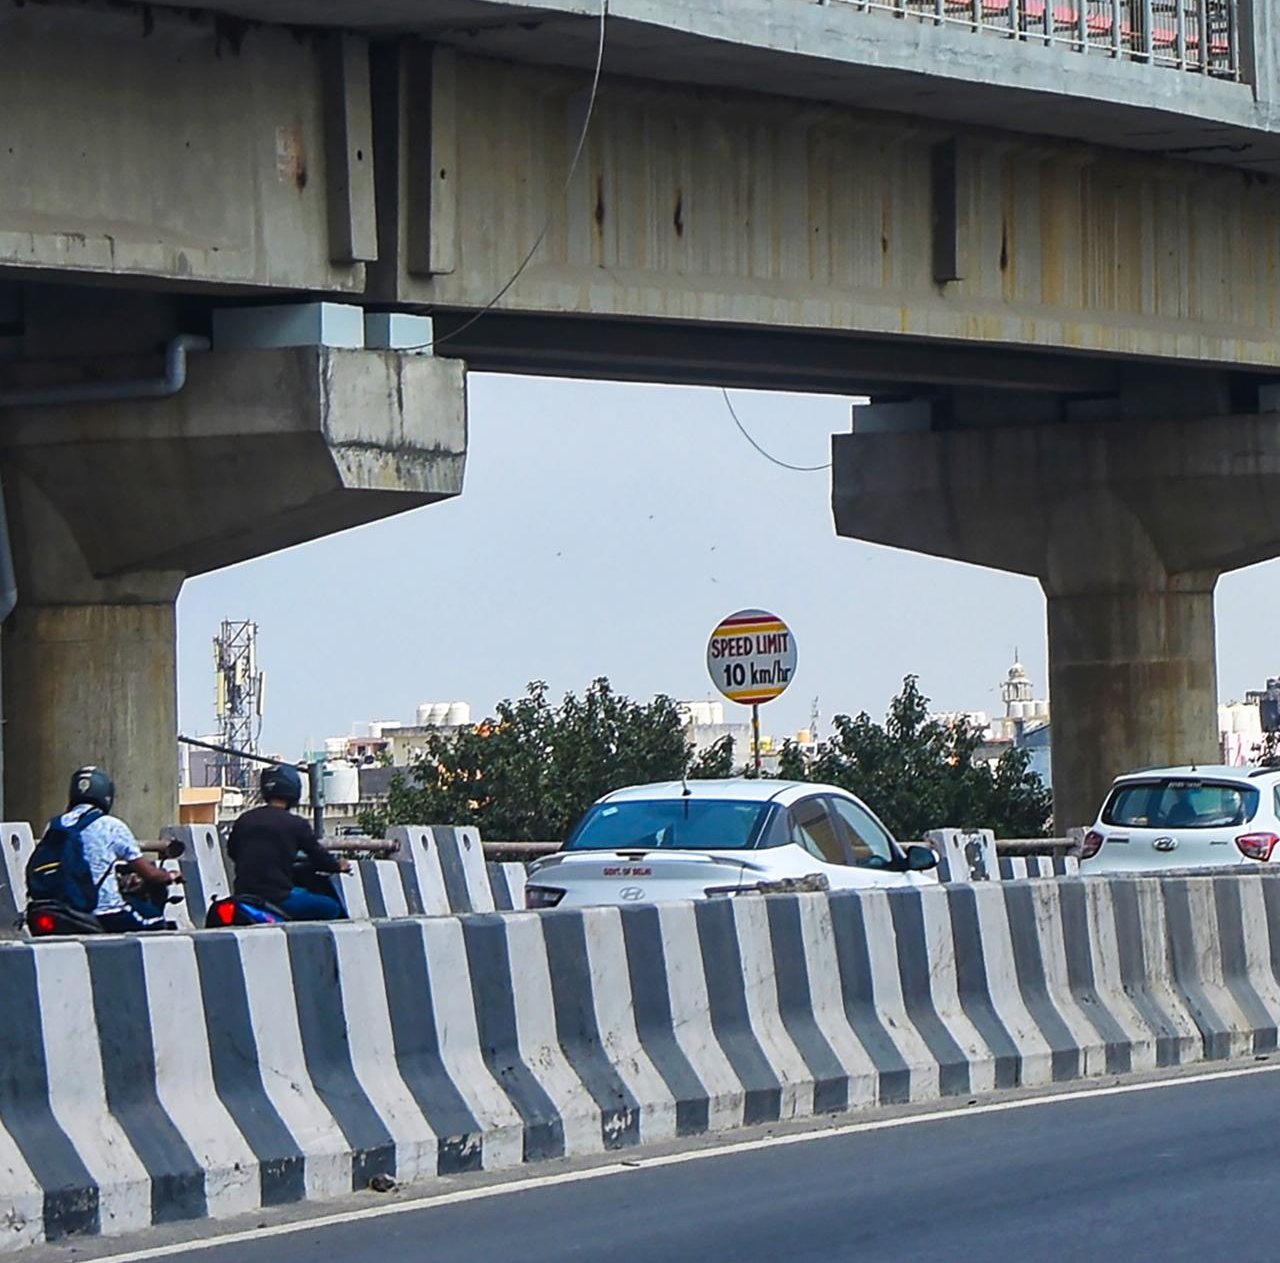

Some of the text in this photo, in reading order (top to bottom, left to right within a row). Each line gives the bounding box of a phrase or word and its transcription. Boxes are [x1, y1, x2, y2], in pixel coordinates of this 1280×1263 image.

[711, 632, 789, 658] SPEED LIMIT
[724, 659, 791, 687] 10 km/hr
